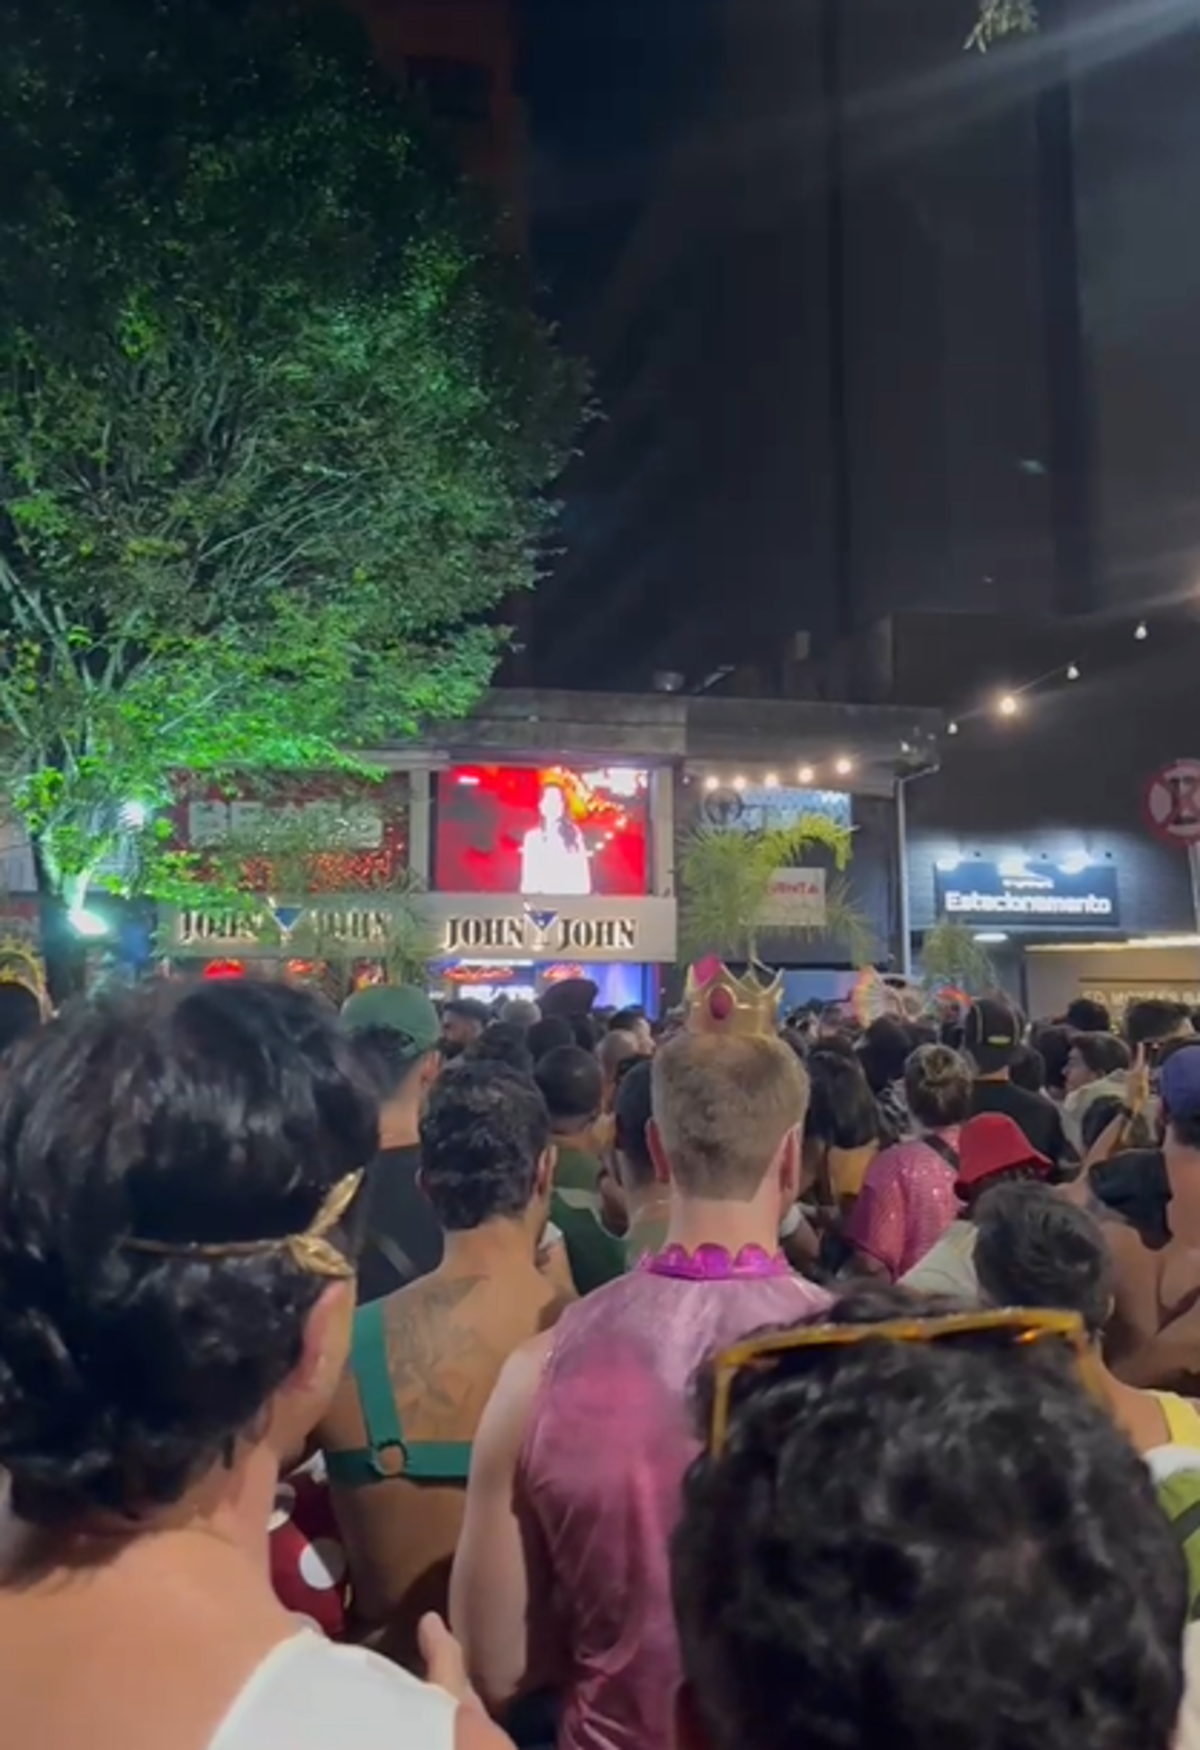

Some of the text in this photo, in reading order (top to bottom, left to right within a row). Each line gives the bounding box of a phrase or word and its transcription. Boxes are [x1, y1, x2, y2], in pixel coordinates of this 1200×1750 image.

[945, 890, 1112, 915] Estacionamento
[441, 917, 637, 953] JOHN JOHN
